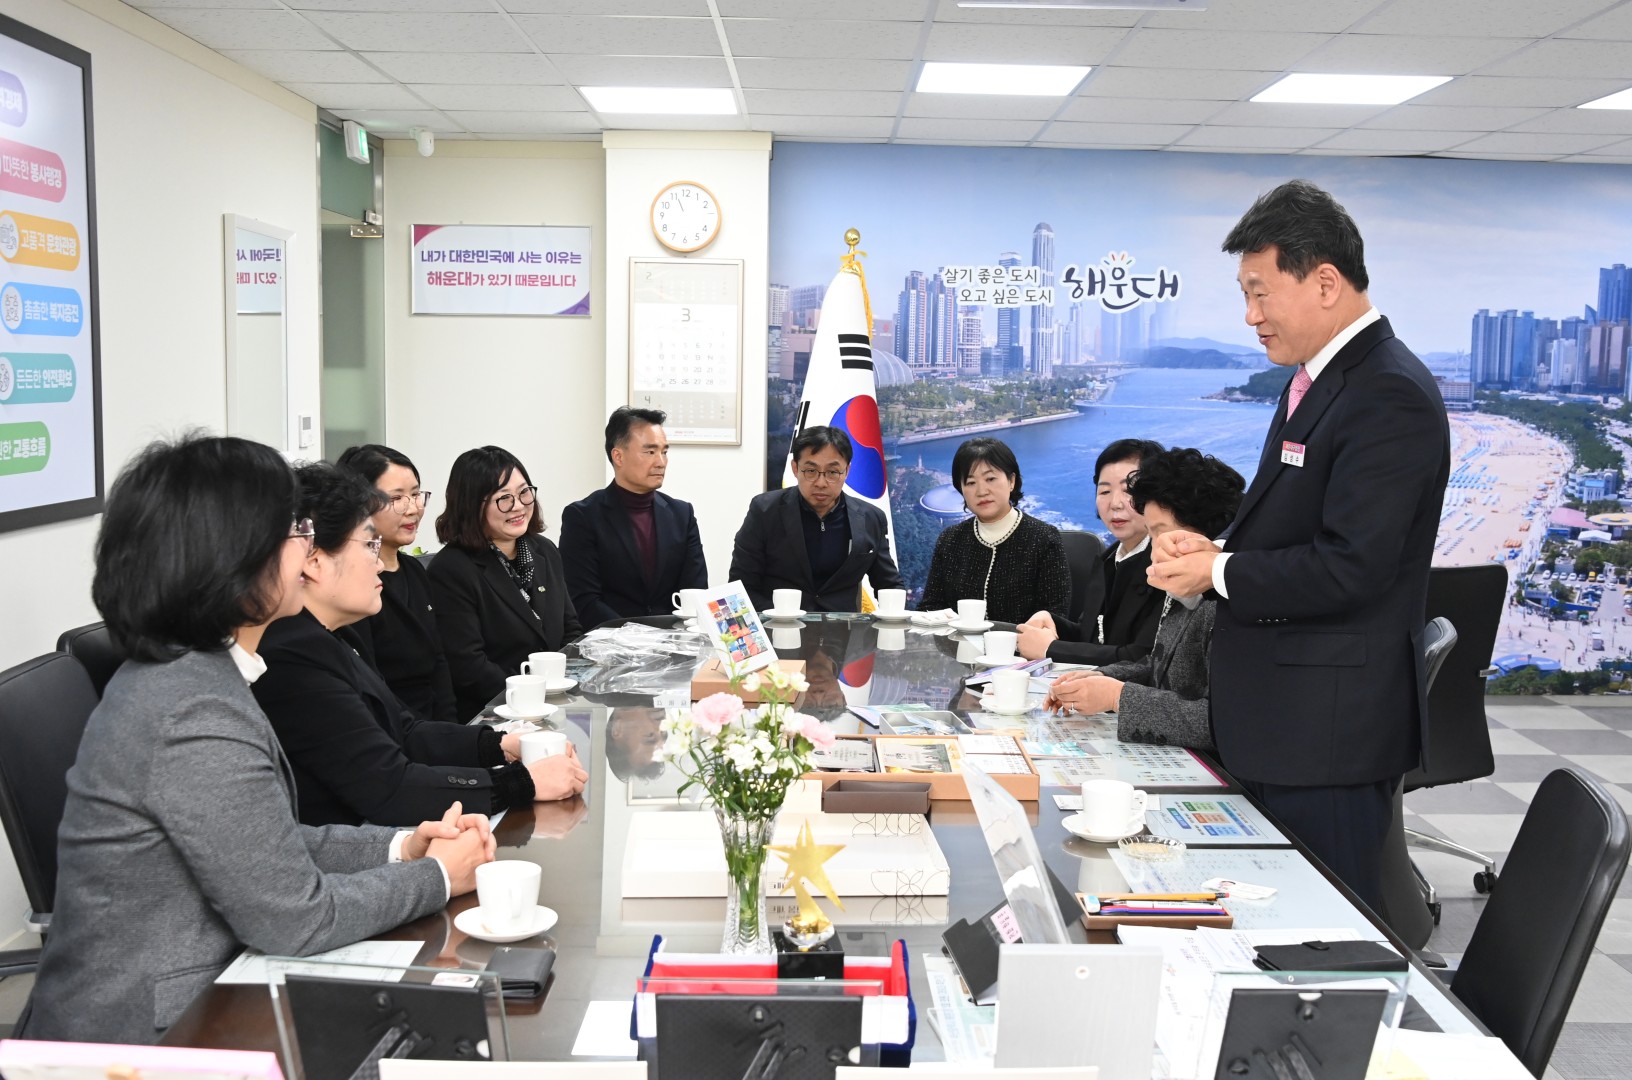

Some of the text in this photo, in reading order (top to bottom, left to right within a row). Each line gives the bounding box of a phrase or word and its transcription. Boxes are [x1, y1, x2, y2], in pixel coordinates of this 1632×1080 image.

[2, 155, 62, 189] 따뜻한 봉사행정
[681, 189, 691, 198] 12
[661, 201, 670, 210] 10
[21, 229, 46, 252] 고품격
[421, 250, 582, 264] 내가 대한민국에 사는 이유는
[427, 271, 577, 287] 해운대가 있기 때문입니다
[944, 268, 1038, 284] 살기 좋은 도시
[1062, 266, 1179, 310] 해운대
[960, 289, 1051, 305] 오고 싶은 도시
[24, 300, 80, 323] 촘촘한 복지증진
[681, 308, 691, 322] 3
[16, 369, 73, 389] 든든한 안전확보
[644, 396, 651, 404] 4
[13, 437, 46, 458] 교통흐름
